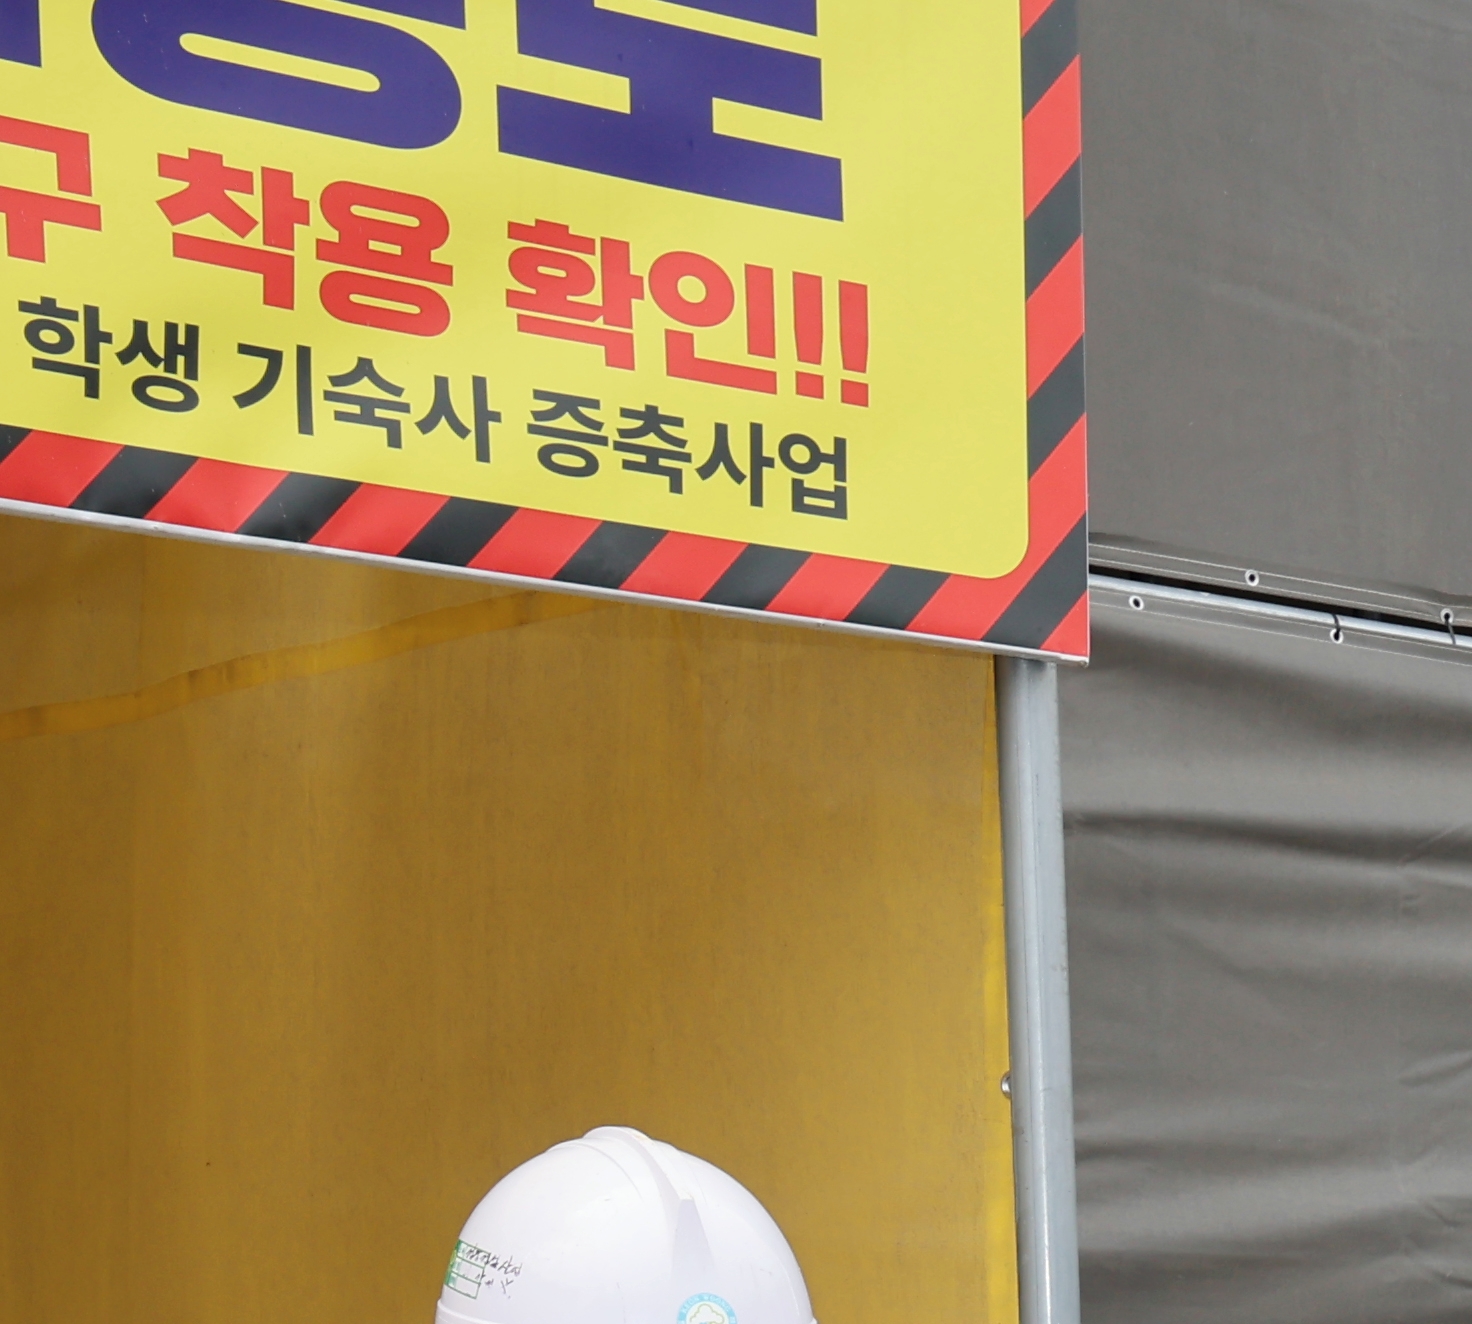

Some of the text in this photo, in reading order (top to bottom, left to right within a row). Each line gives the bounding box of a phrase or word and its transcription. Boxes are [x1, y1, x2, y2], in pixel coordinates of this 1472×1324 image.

[155, 146, 454, 338] 착용
[505, 218, 870, 407] 확인!!
[17, 296, 850, 522] 학생 기숙사 증축사업
